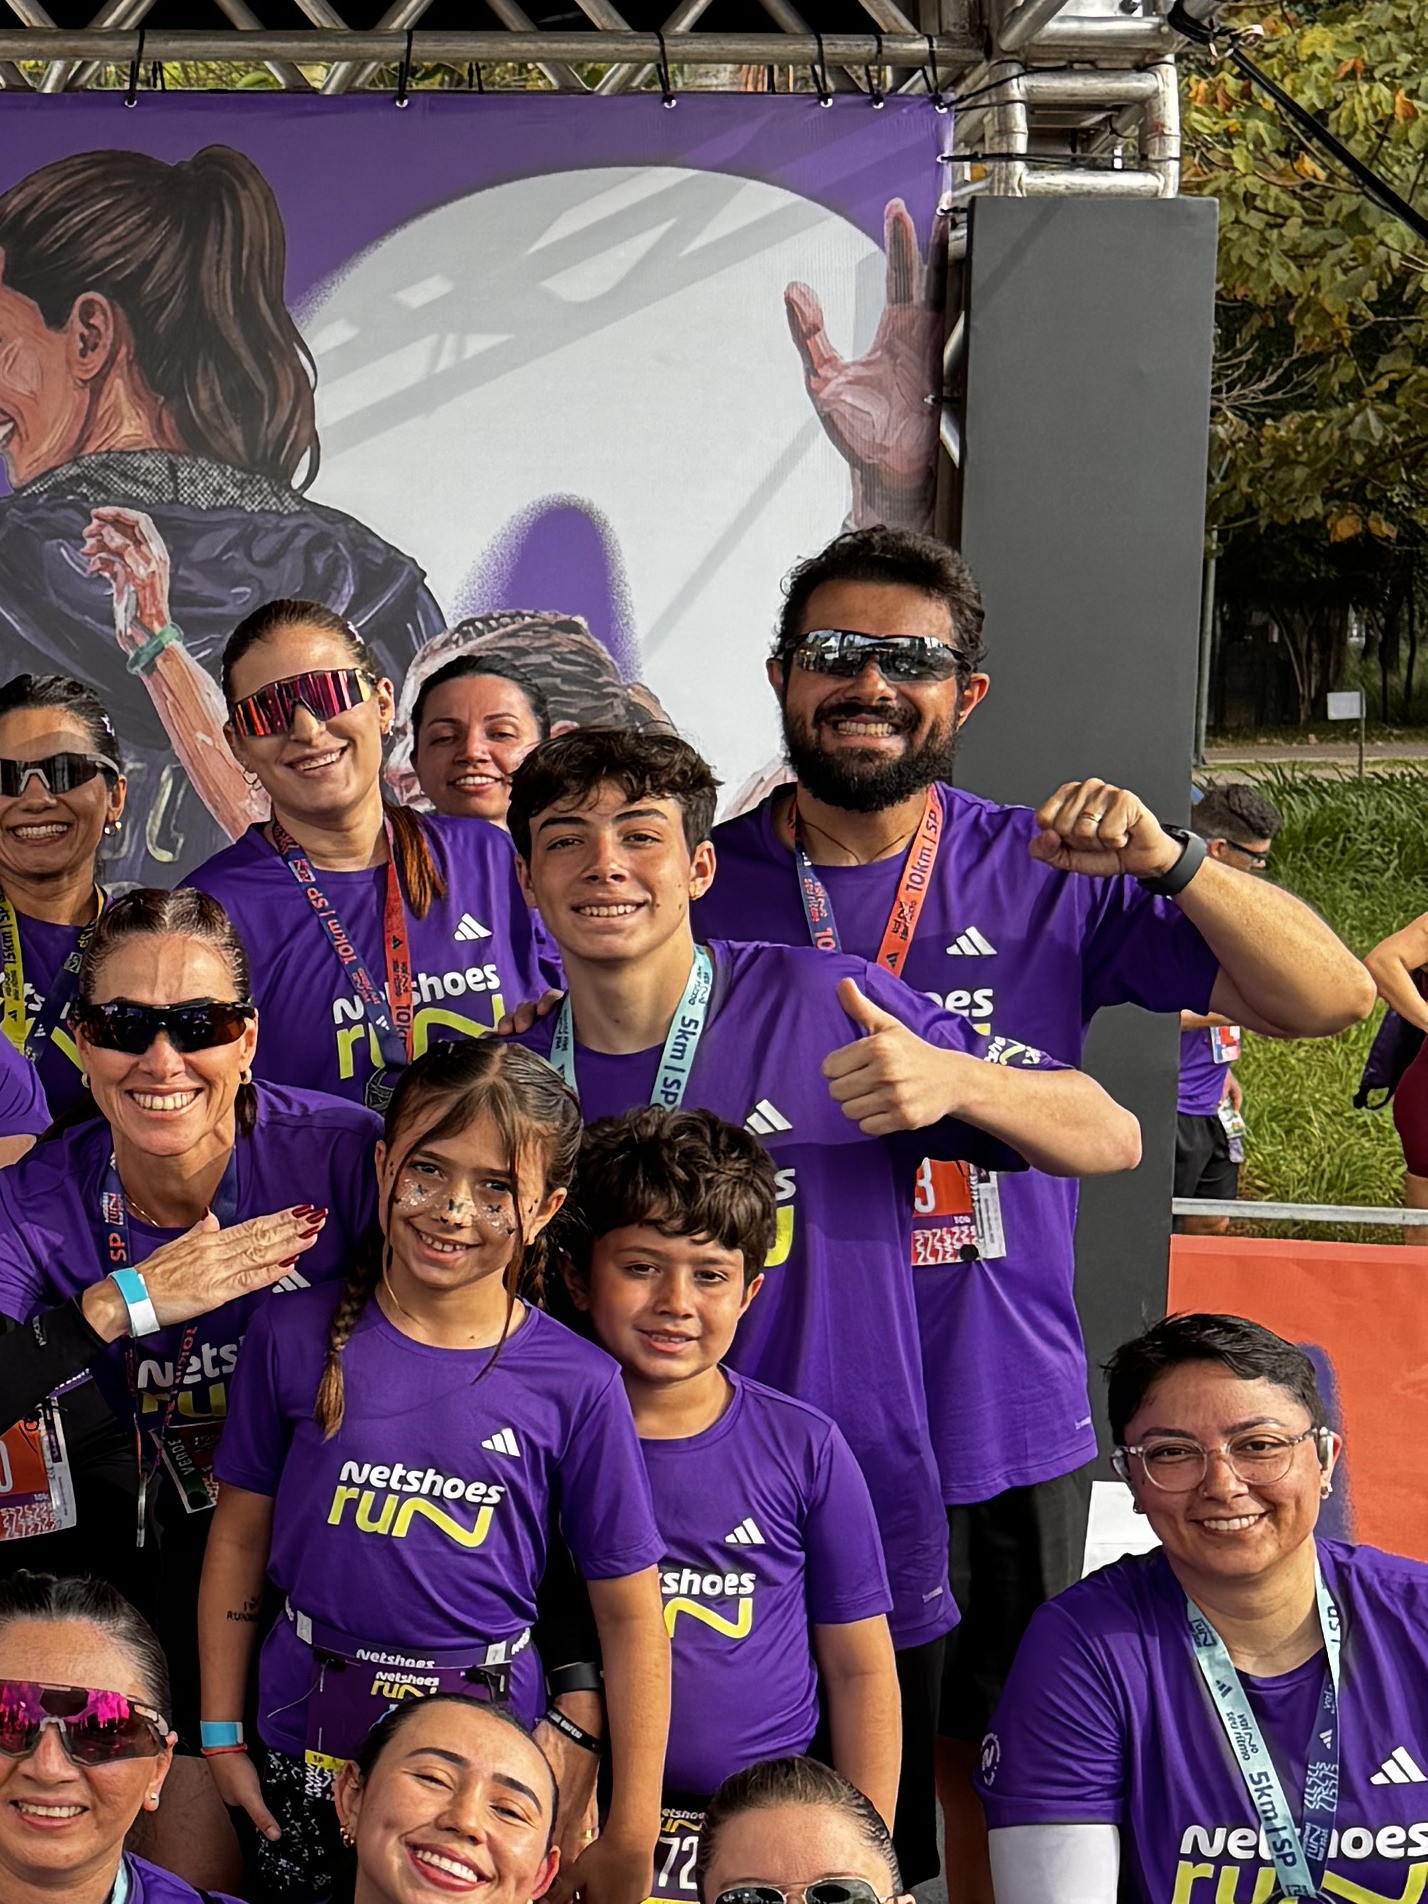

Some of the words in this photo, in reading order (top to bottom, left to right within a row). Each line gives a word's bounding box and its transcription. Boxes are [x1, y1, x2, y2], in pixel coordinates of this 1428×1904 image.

[906, 845, 934, 894] 10km
[925, 810, 939, 834] SP
[3, 930, 16, 965] 15km
[306, 887, 330, 909] SP
[325, 919, 358, 965] 10km
[669, 1015, 700, 1062] 5km
[108, 1232, 128, 1262] SP
[138, 1342, 239, 1389] Nets
[169, 1438, 196, 1478] VERDE
[338, 1459, 507, 1505] Netshoes
[326, 1484, 495, 1549] run
[660, 1569, 757, 1597] shoes
[355, 1647, 436, 1670] Netshoes
[375, 1670, 441, 1687] Netshoes
[1248, 1770, 1279, 1823] 5km
[1271, 1838, 1299, 1869] SP
